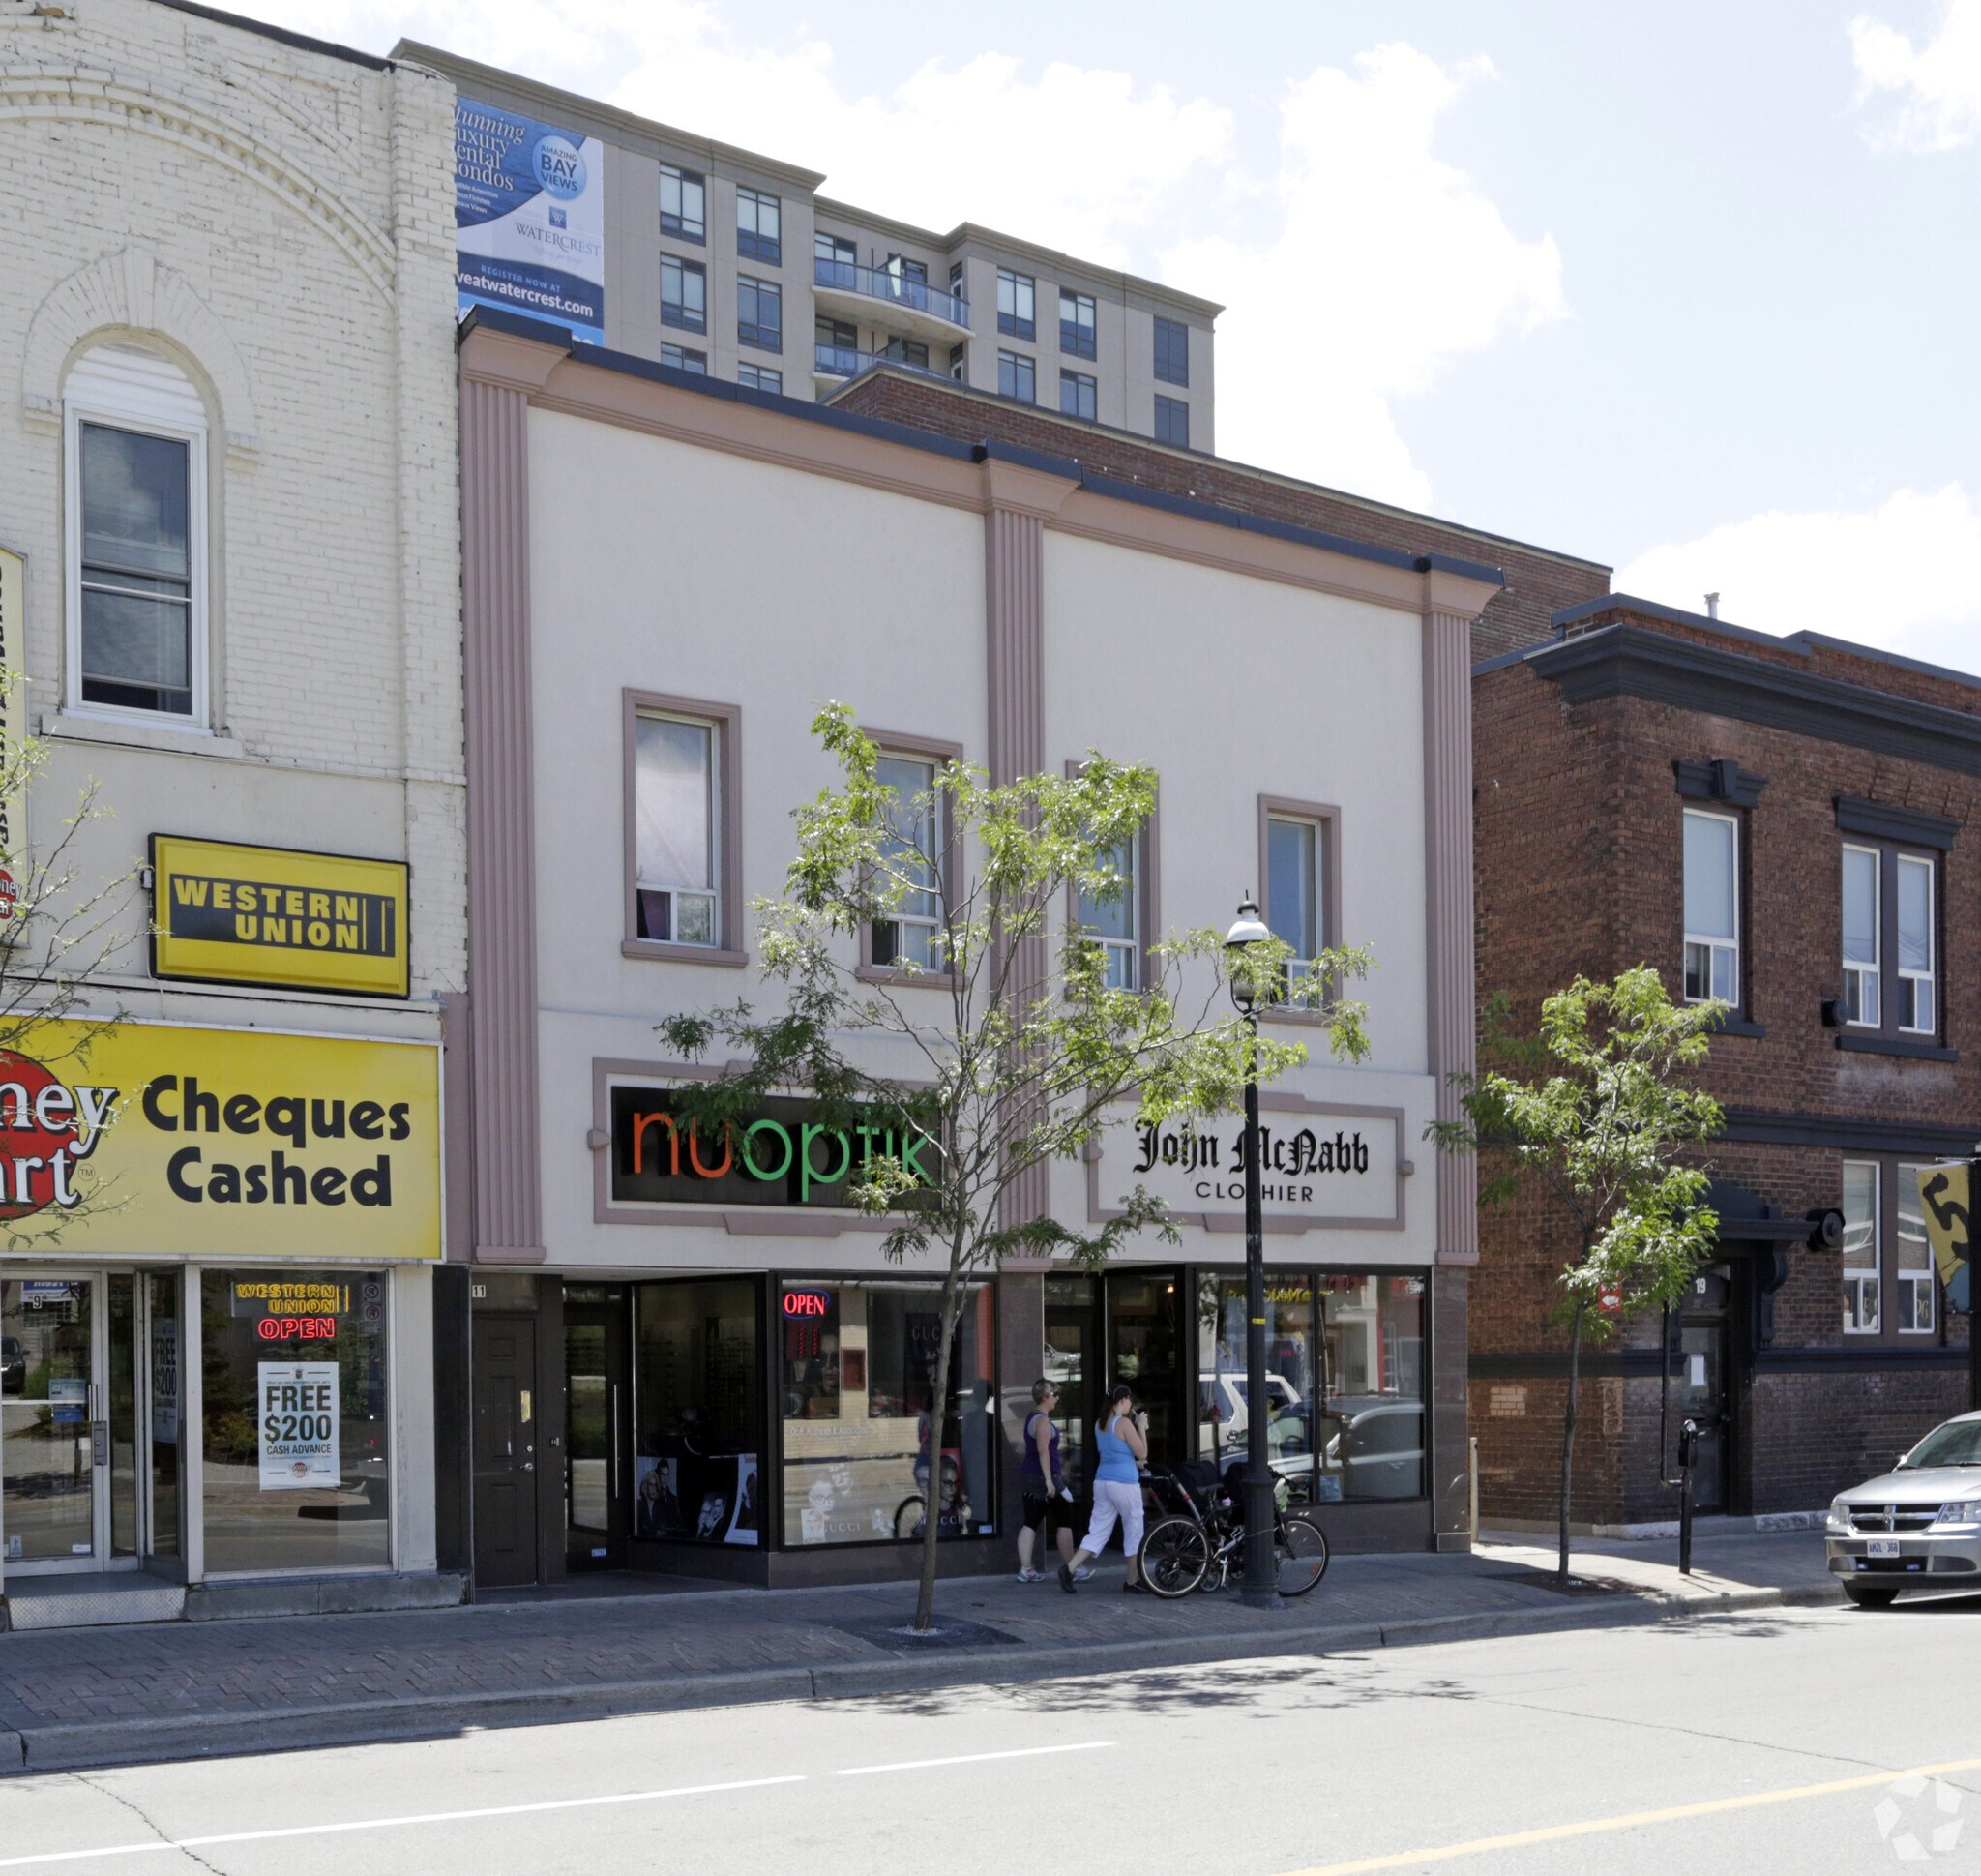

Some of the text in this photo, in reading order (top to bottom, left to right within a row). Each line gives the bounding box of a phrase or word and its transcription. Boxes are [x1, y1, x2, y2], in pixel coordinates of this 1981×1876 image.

[456, 106, 525, 145] tunning
[457, 127, 509, 158] uxury
[541, 145, 577, 162] AMAZING
[457, 145, 501, 170] ental
[542, 153, 577, 179] BAY
[458, 163, 514, 192] ondos
[541, 171, 577, 192] VIEWS
[516, 223, 601, 256] WATERCREST
[481, 264, 561, 292] REGISTER NOW AT
[457, 272, 594, 318] veatwatercrest.com
[0, 879, 22, 901] ney
[173, 878, 358, 921] WESTERN
[235, 914, 358, 949] UNION
[0, 1083, 120, 1158] ney
[142, 1074, 411, 1148] Cheques
[1133, 1120, 1369, 1176] John McNabb
[0, 1148, 82, 1208] rt
[167, 1146, 392, 1206] Cashed
[1196, 1181, 1314, 1202] CLOHIER
[236, 1284, 336, 1298] WESTERN
[474, 1286, 485, 1297] 11
[1695, 1277, 1706, 1294] 19
[34, 1295, 41, 1308] 9
[268, 1299, 335, 1313] UNION
[784, 1293, 825, 1316] OPEN
[258, 1317, 336, 1340] OPEN
[912, 1325, 956, 1341] GUCI
[266, 1385, 331, 1412] FREE
[265, 1414, 332, 1444] $200
[267, 1444, 332, 1455] CASH ADVANCE
